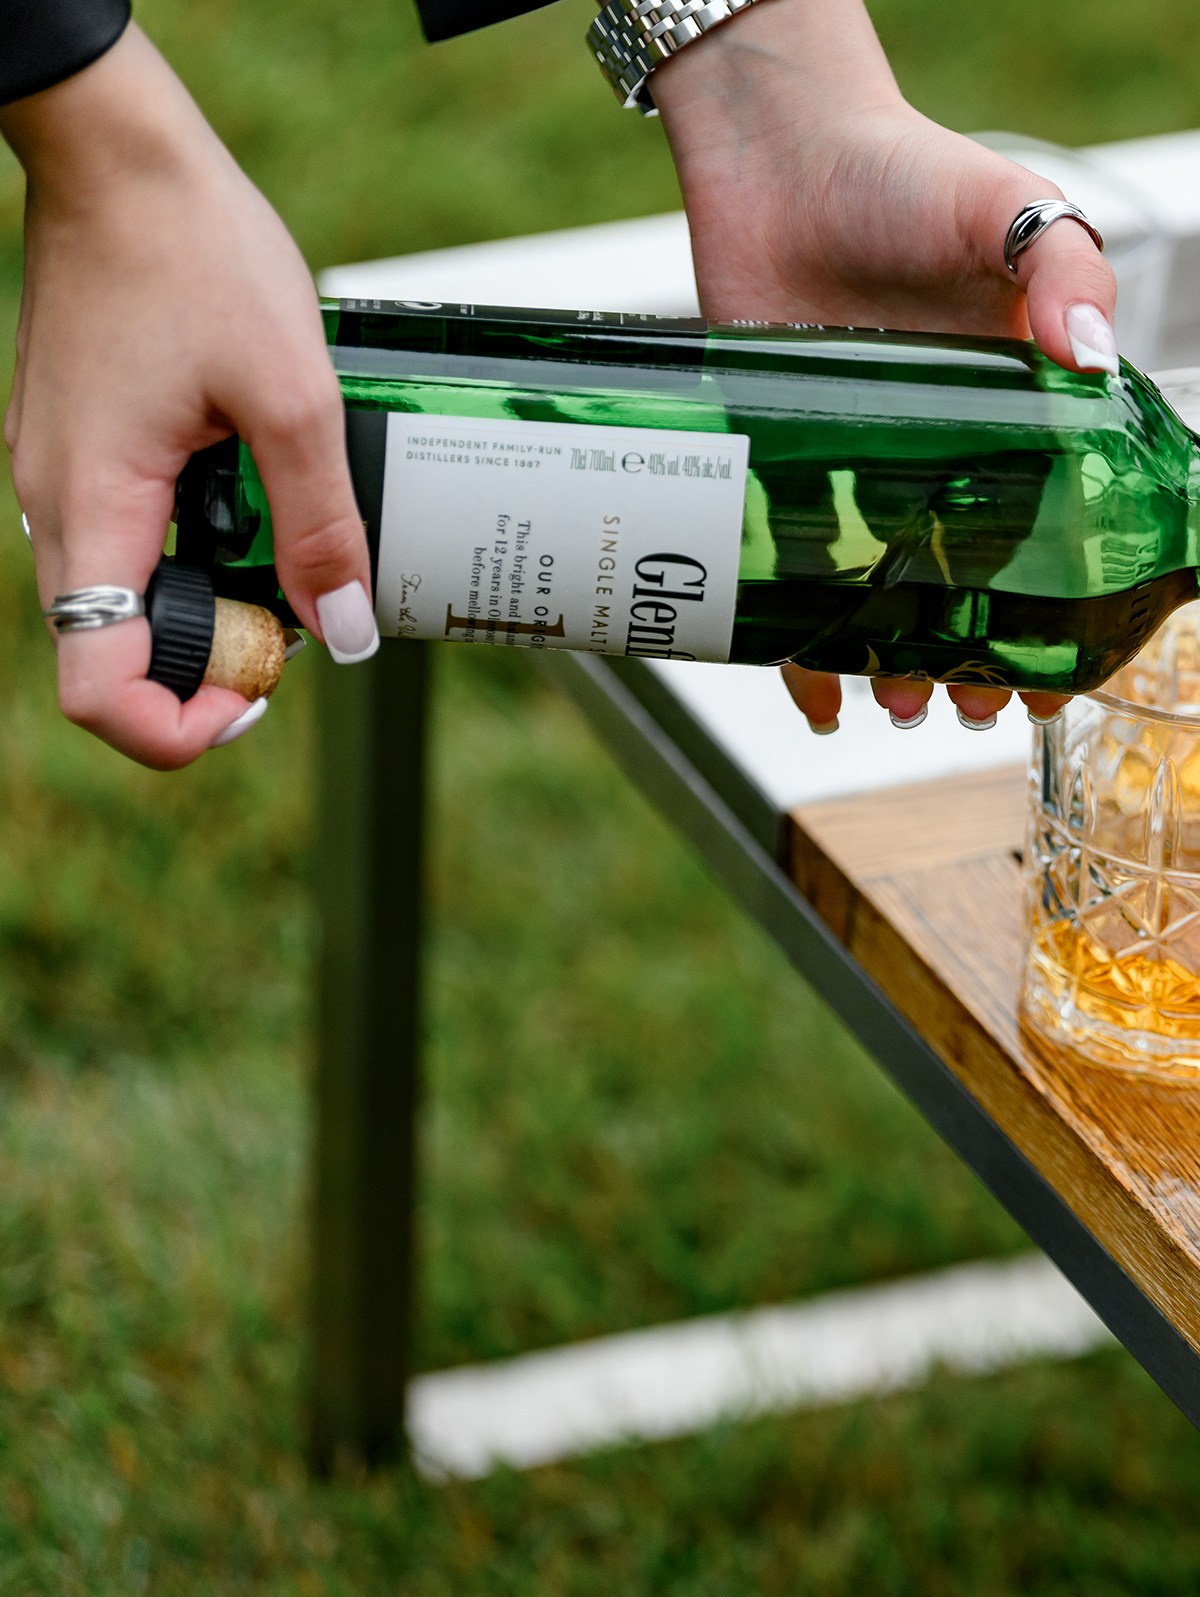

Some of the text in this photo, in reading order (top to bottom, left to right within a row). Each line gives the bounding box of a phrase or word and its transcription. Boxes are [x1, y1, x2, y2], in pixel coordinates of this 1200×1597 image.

[406, 450, 541, 469] DISTILLERS SINCE 1887
[407, 436, 562, 456] INDEPENDENT FAMILY-RUN
[496, 513, 511, 534] for
[514, 520, 531, 551] This
[494, 540, 508, 555] 12
[595, 515, 621, 595] SINGLE
[470, 546, 487, 588] before
[490, 557, 503, 592] years
[508, 555, 528, 594] bright
[536, 554, 555, 595] OUR
[398, 607, 417, 622] the
[461, 590, 481, 640] mellowing
[488, 594, 502, 606] in
[508, 597, 522, 619] and
[589, 605, 611, 645] MALT
